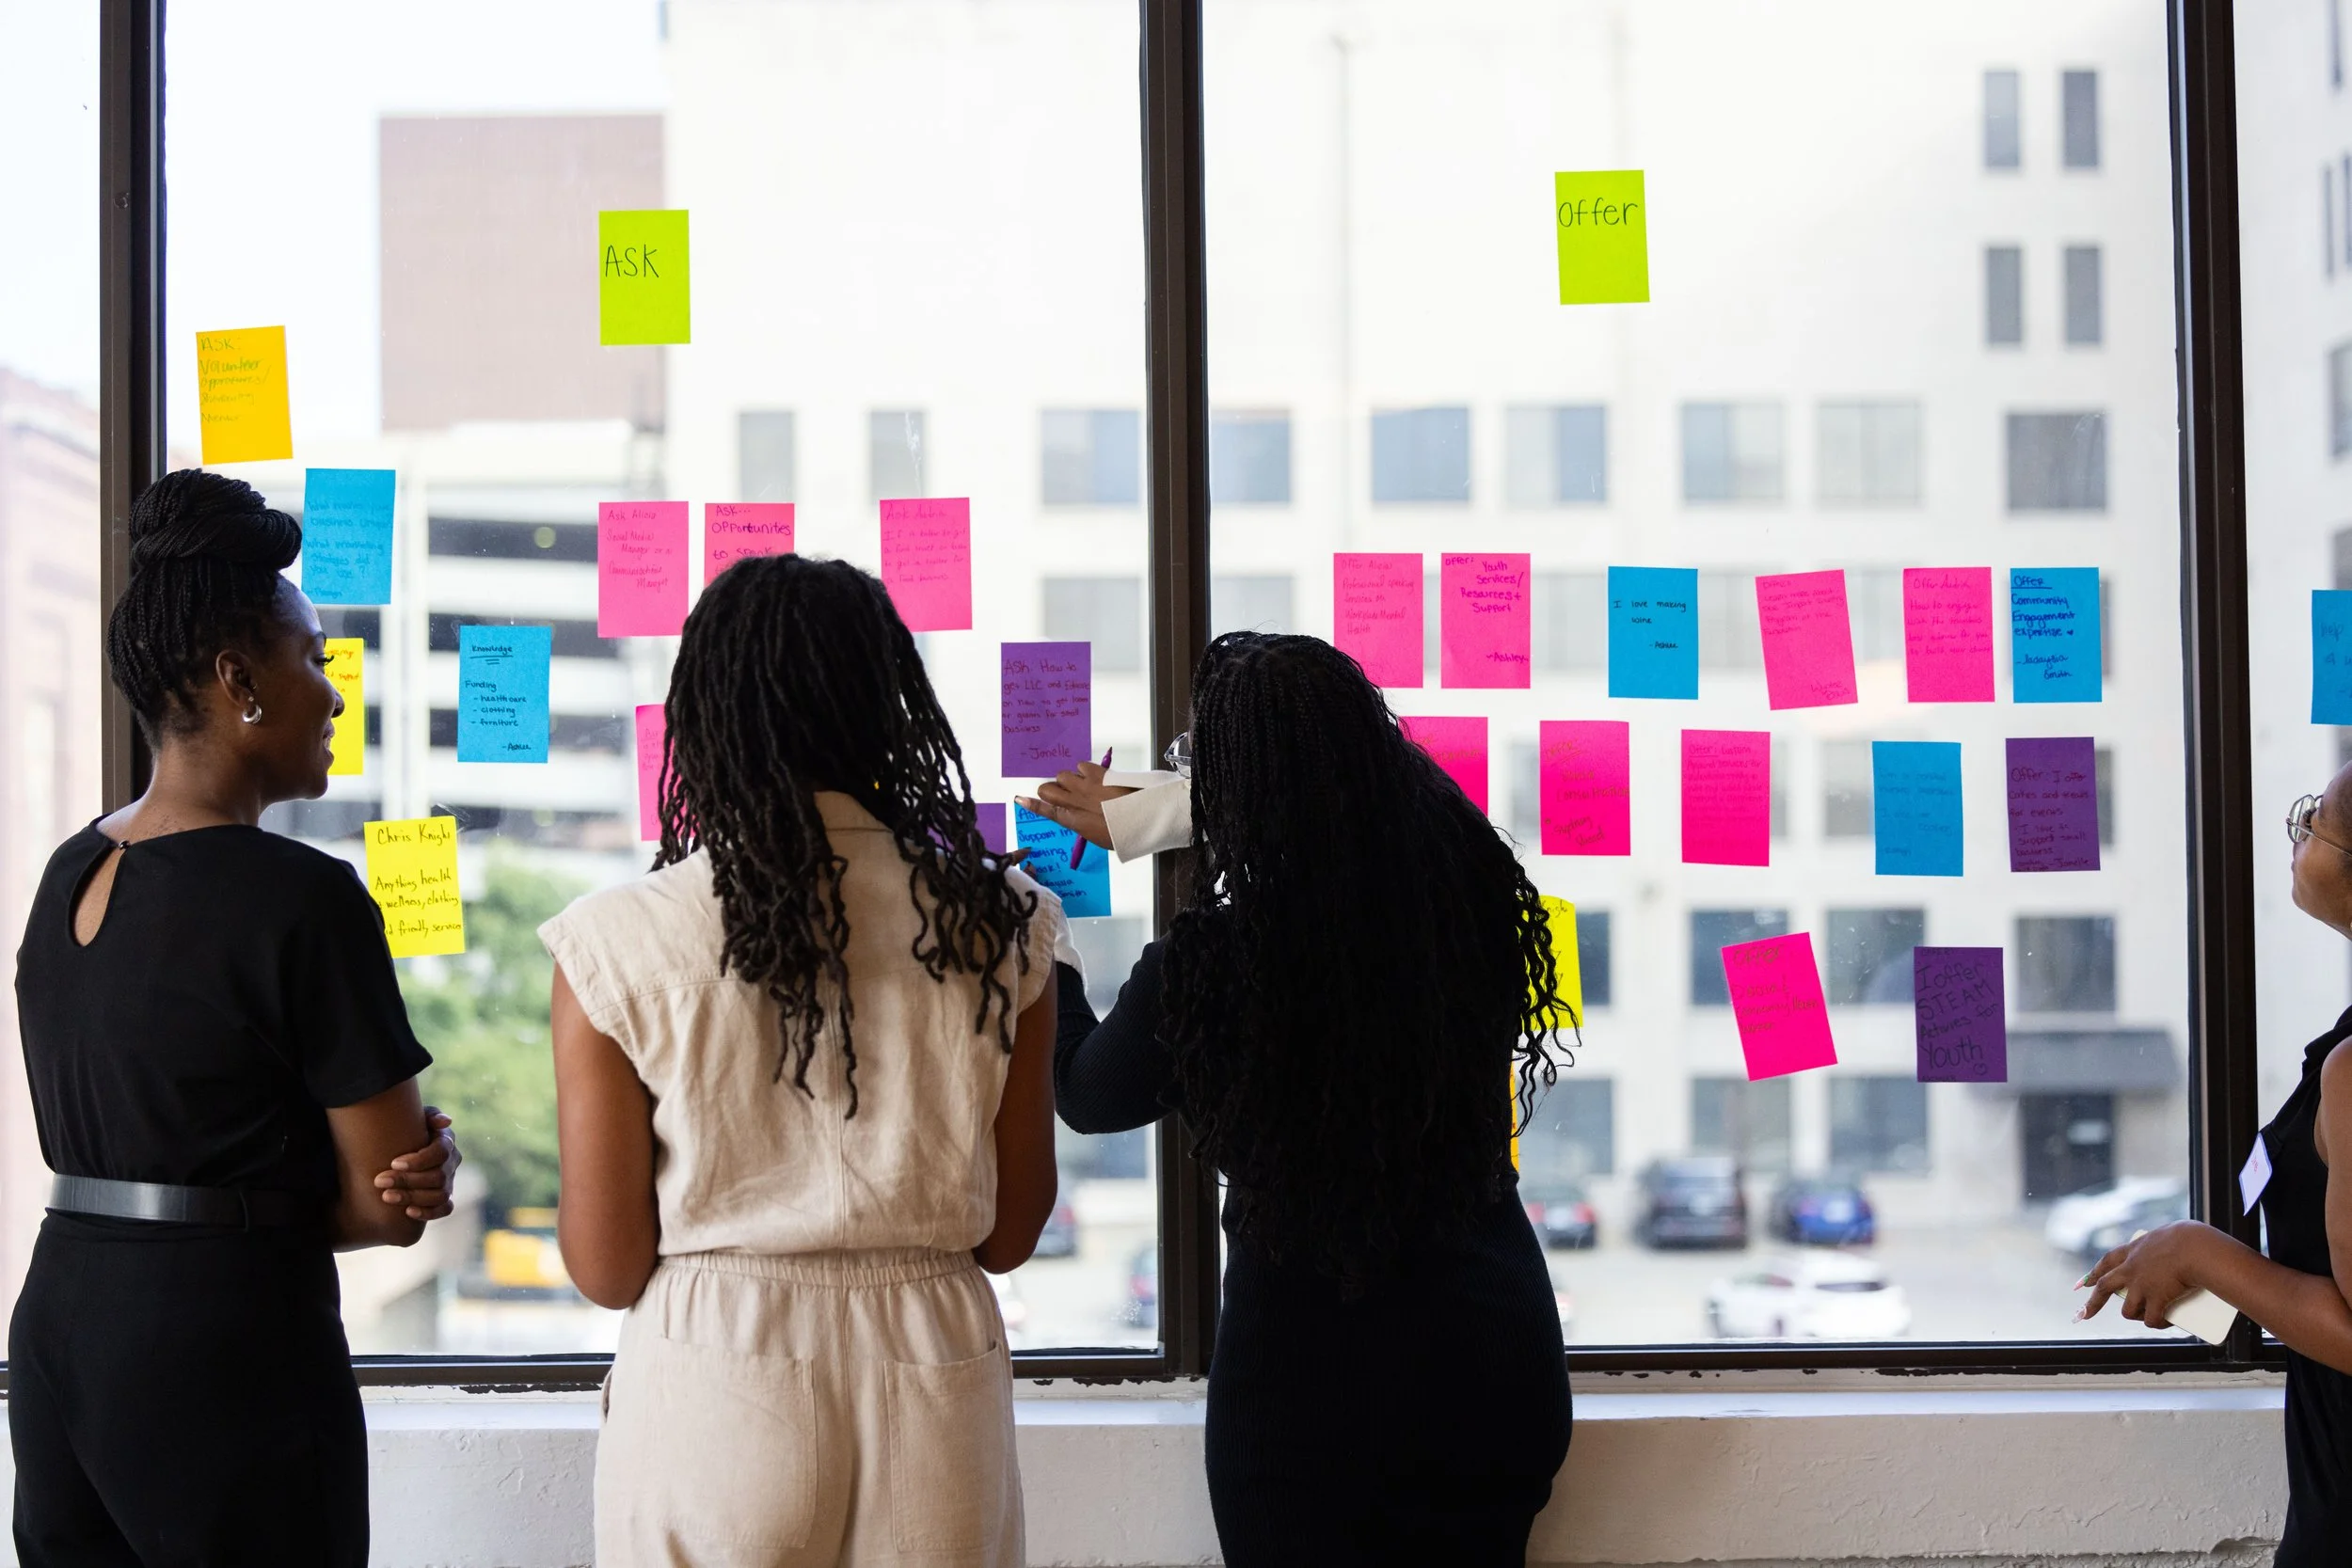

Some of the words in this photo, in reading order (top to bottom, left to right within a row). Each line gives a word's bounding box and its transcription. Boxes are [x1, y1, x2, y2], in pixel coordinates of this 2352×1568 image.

[1558, 197, 1639, 228] Offer
[605, 244, 660, 278] ASK
[713, 549, 728, 560] to
[1482, 560, 1507, 572] Youth
[1613, 599, 1622, 609] I
[1631, 599, 1648, 609] love
[1656, 601, 1687, 613] making
[2011, 593, 2070, 609] Community
[1631, 616, 1653, 625] wine
[2012, 610, 2075, 628] Engagement
[1040, 658, 1063, 672] How
[1066, 661, 1077, 672] to
[465, 679, 497, 692] Funding
[481, 706, 516, 718] clothing
[377, 827, 412, 846] Chris
[375, 876, 417, 895] Anything
[421, 867, 452, 884] health
[427, 889, 459, 906] clothing
[397, 919, 429, 938] friendly
[1916, 965, 1932, 992] I
[1933, 962, 1985, 989] offer
[1975, 1003, 1998, 1020] for
[1920, 1035, 1985, 1069] Youth
